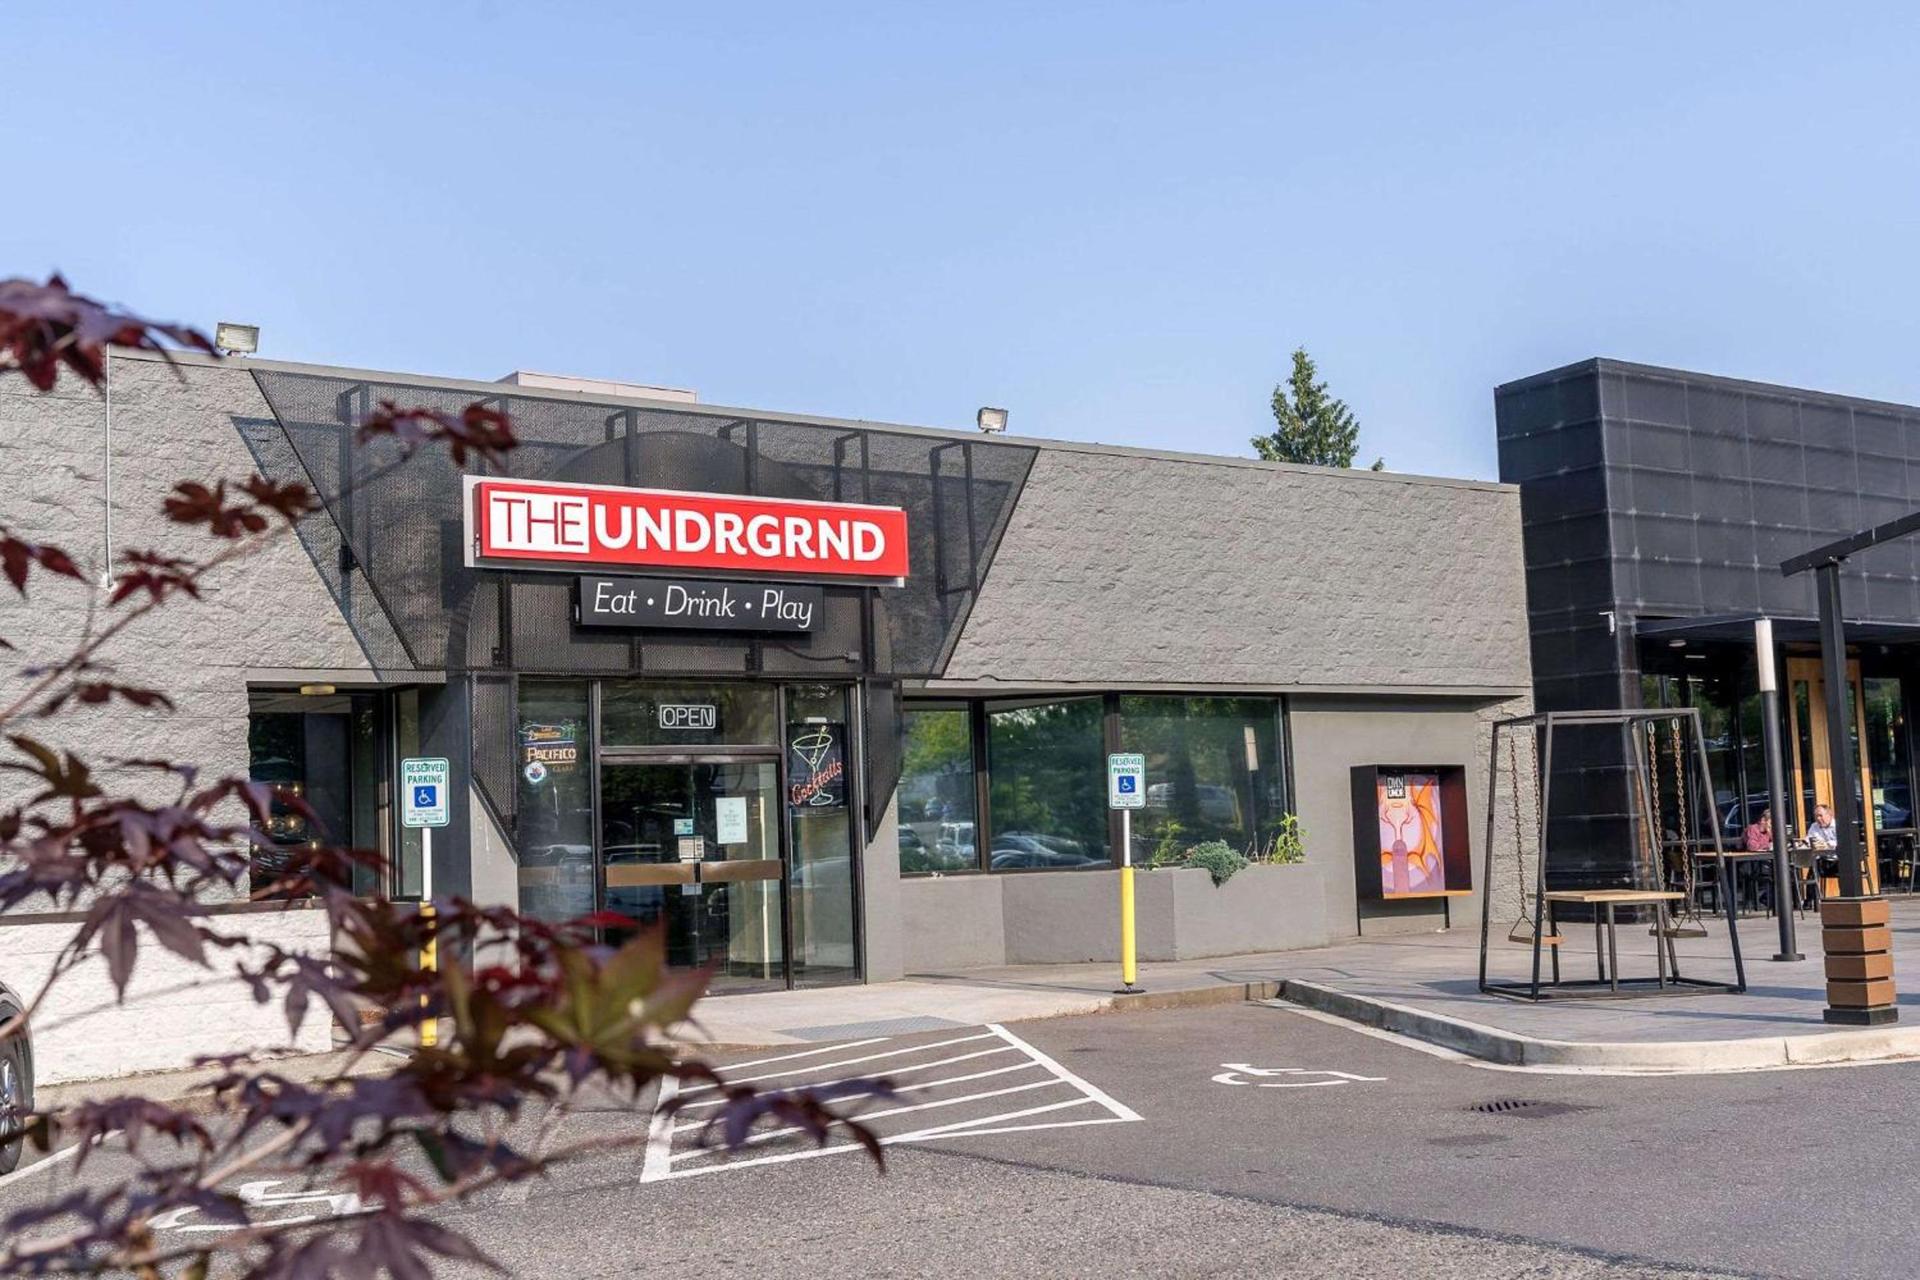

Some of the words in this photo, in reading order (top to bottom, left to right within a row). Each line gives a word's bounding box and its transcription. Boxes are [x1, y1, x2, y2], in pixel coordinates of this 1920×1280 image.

[492, 496, 584, 547] THE
[594, 503, 886, 562] UNDRGRND
[594, 582, 637, 614] Eat
[664, 585, 736, 618] Drink
[761, 589, 813, 629] Play
[663, 707, 713, 727] OPEN
[527, 747, 577, 762] PACIFICO
[406, 763, 445, 773] RESERVED
[407, 775, 443, 784] PARKING
[792, 758, 843, 805] Cocktails
